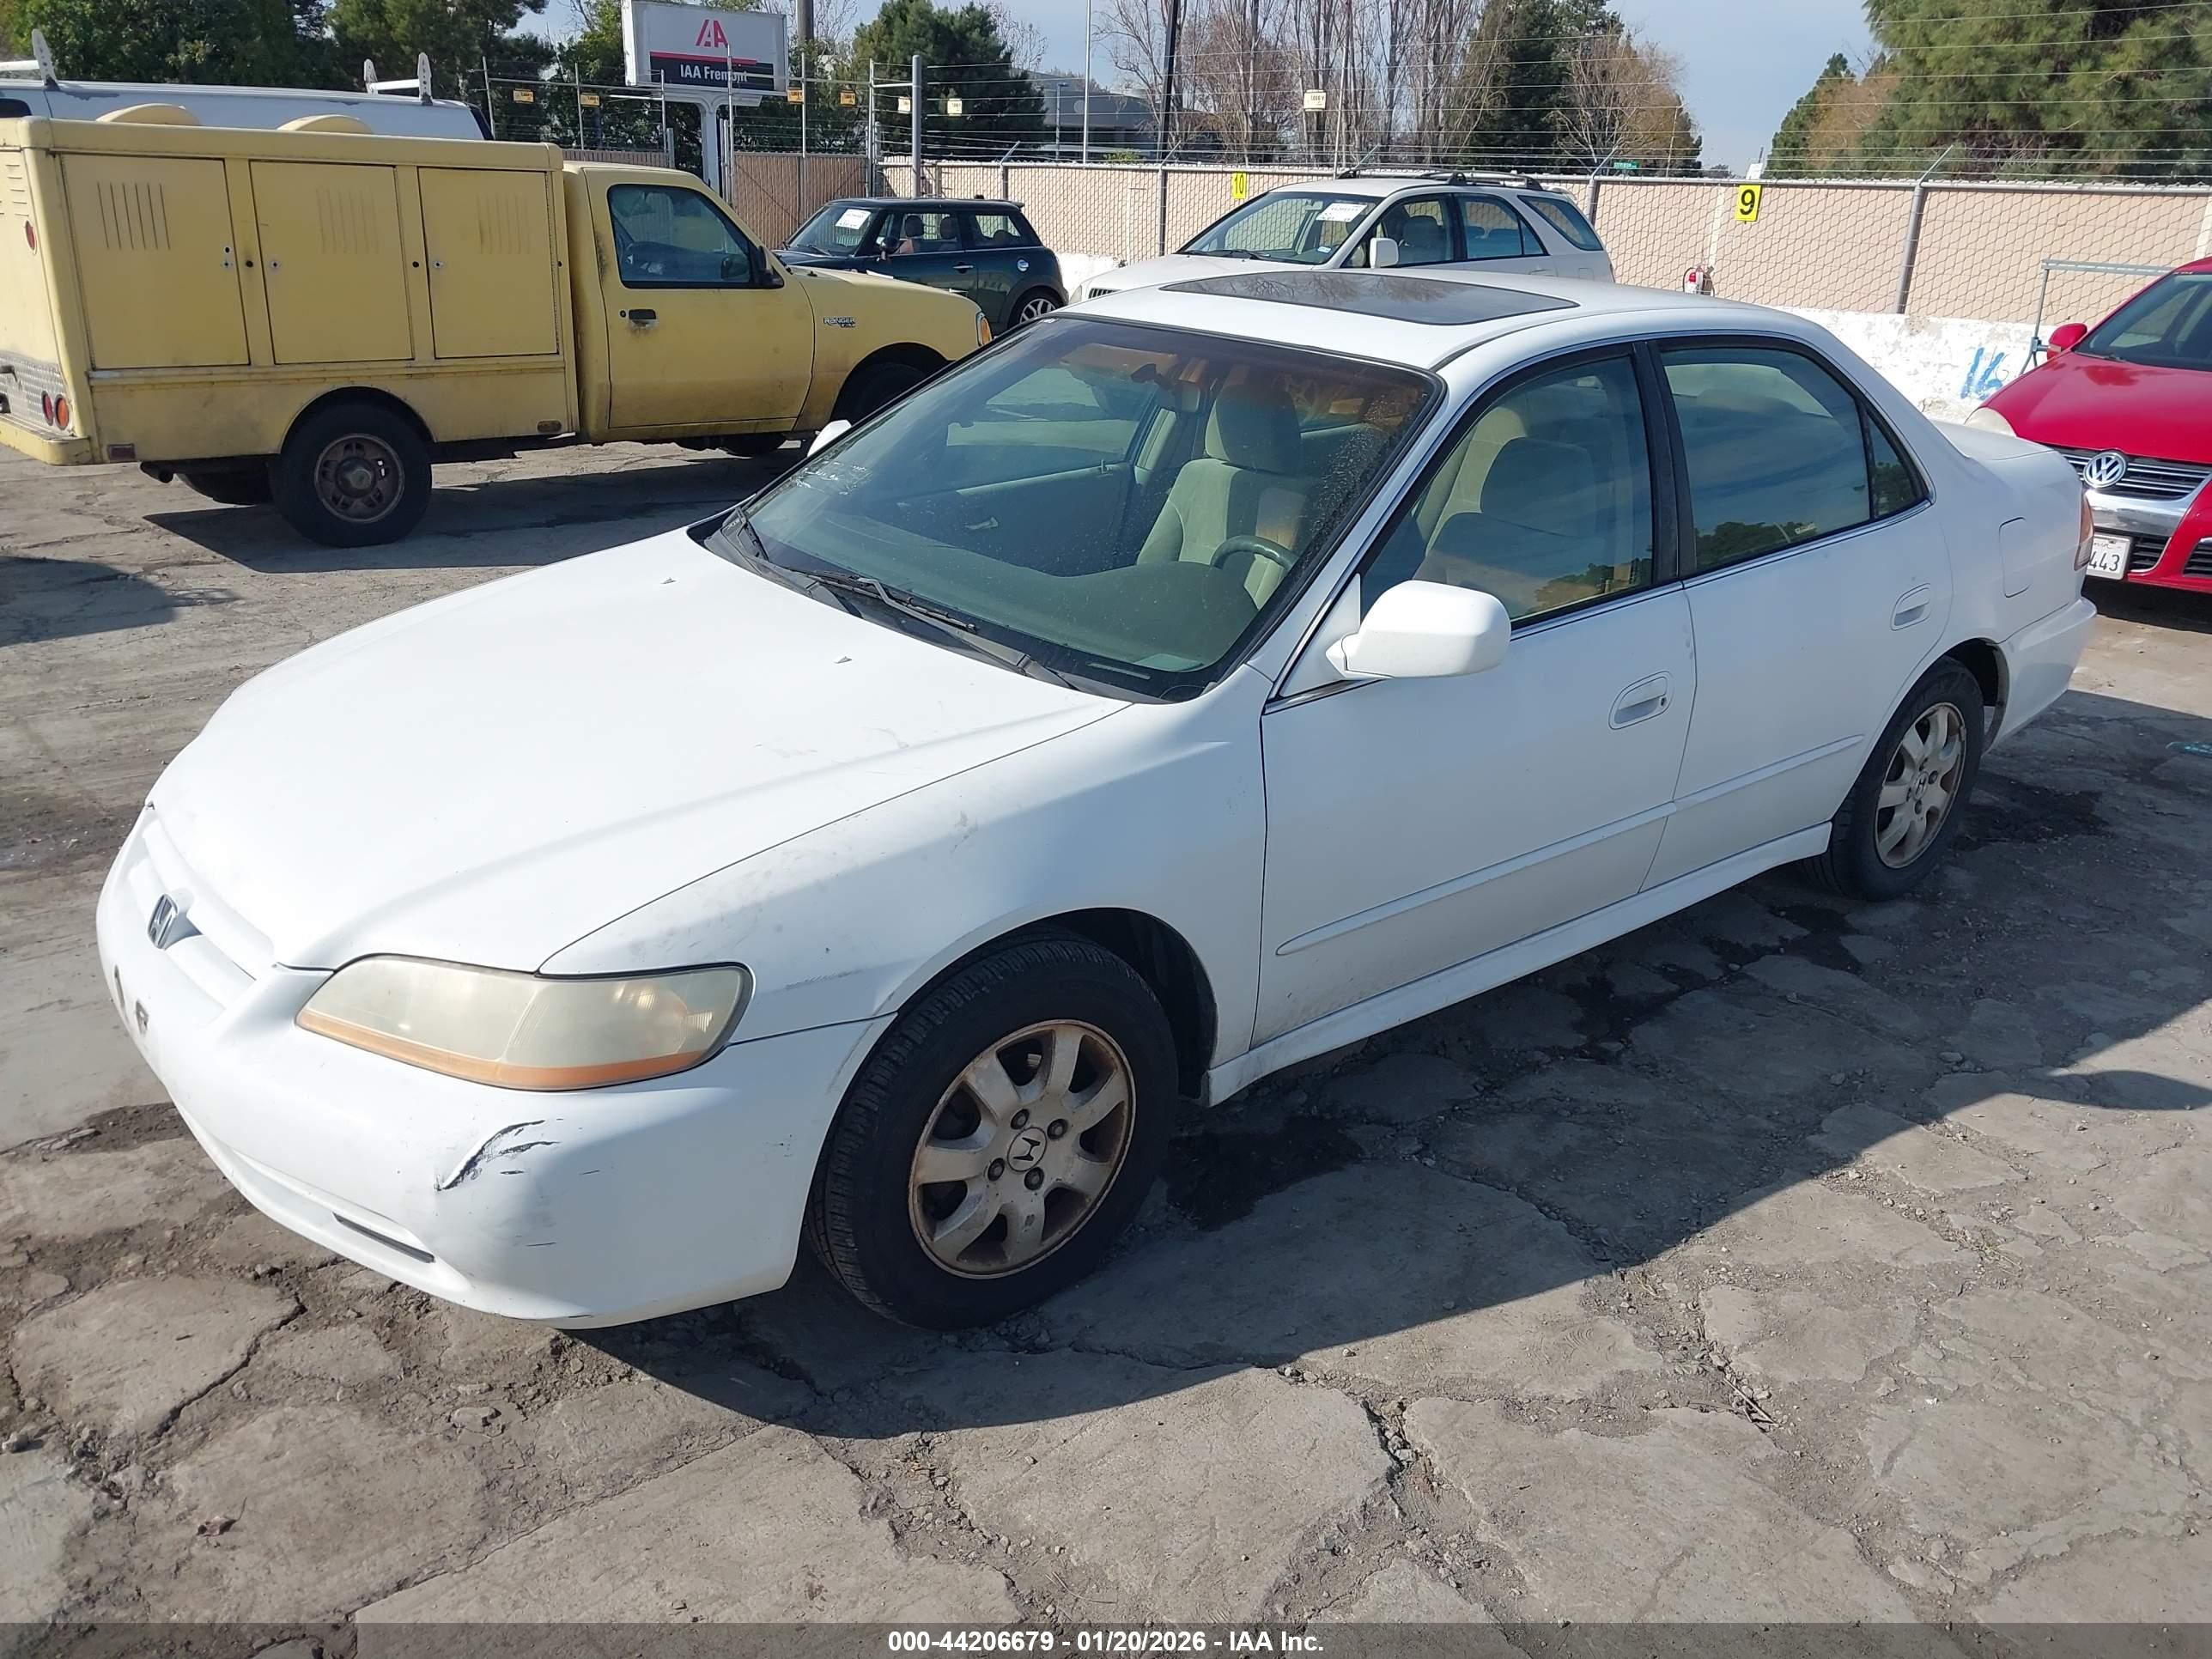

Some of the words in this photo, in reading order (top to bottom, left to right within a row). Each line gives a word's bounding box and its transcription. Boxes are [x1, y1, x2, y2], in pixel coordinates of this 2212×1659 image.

[680, 64, 702, 79] IAA
[1234, 173, 1244, 194] 10
[1740, 189, 1755, 215] 9
